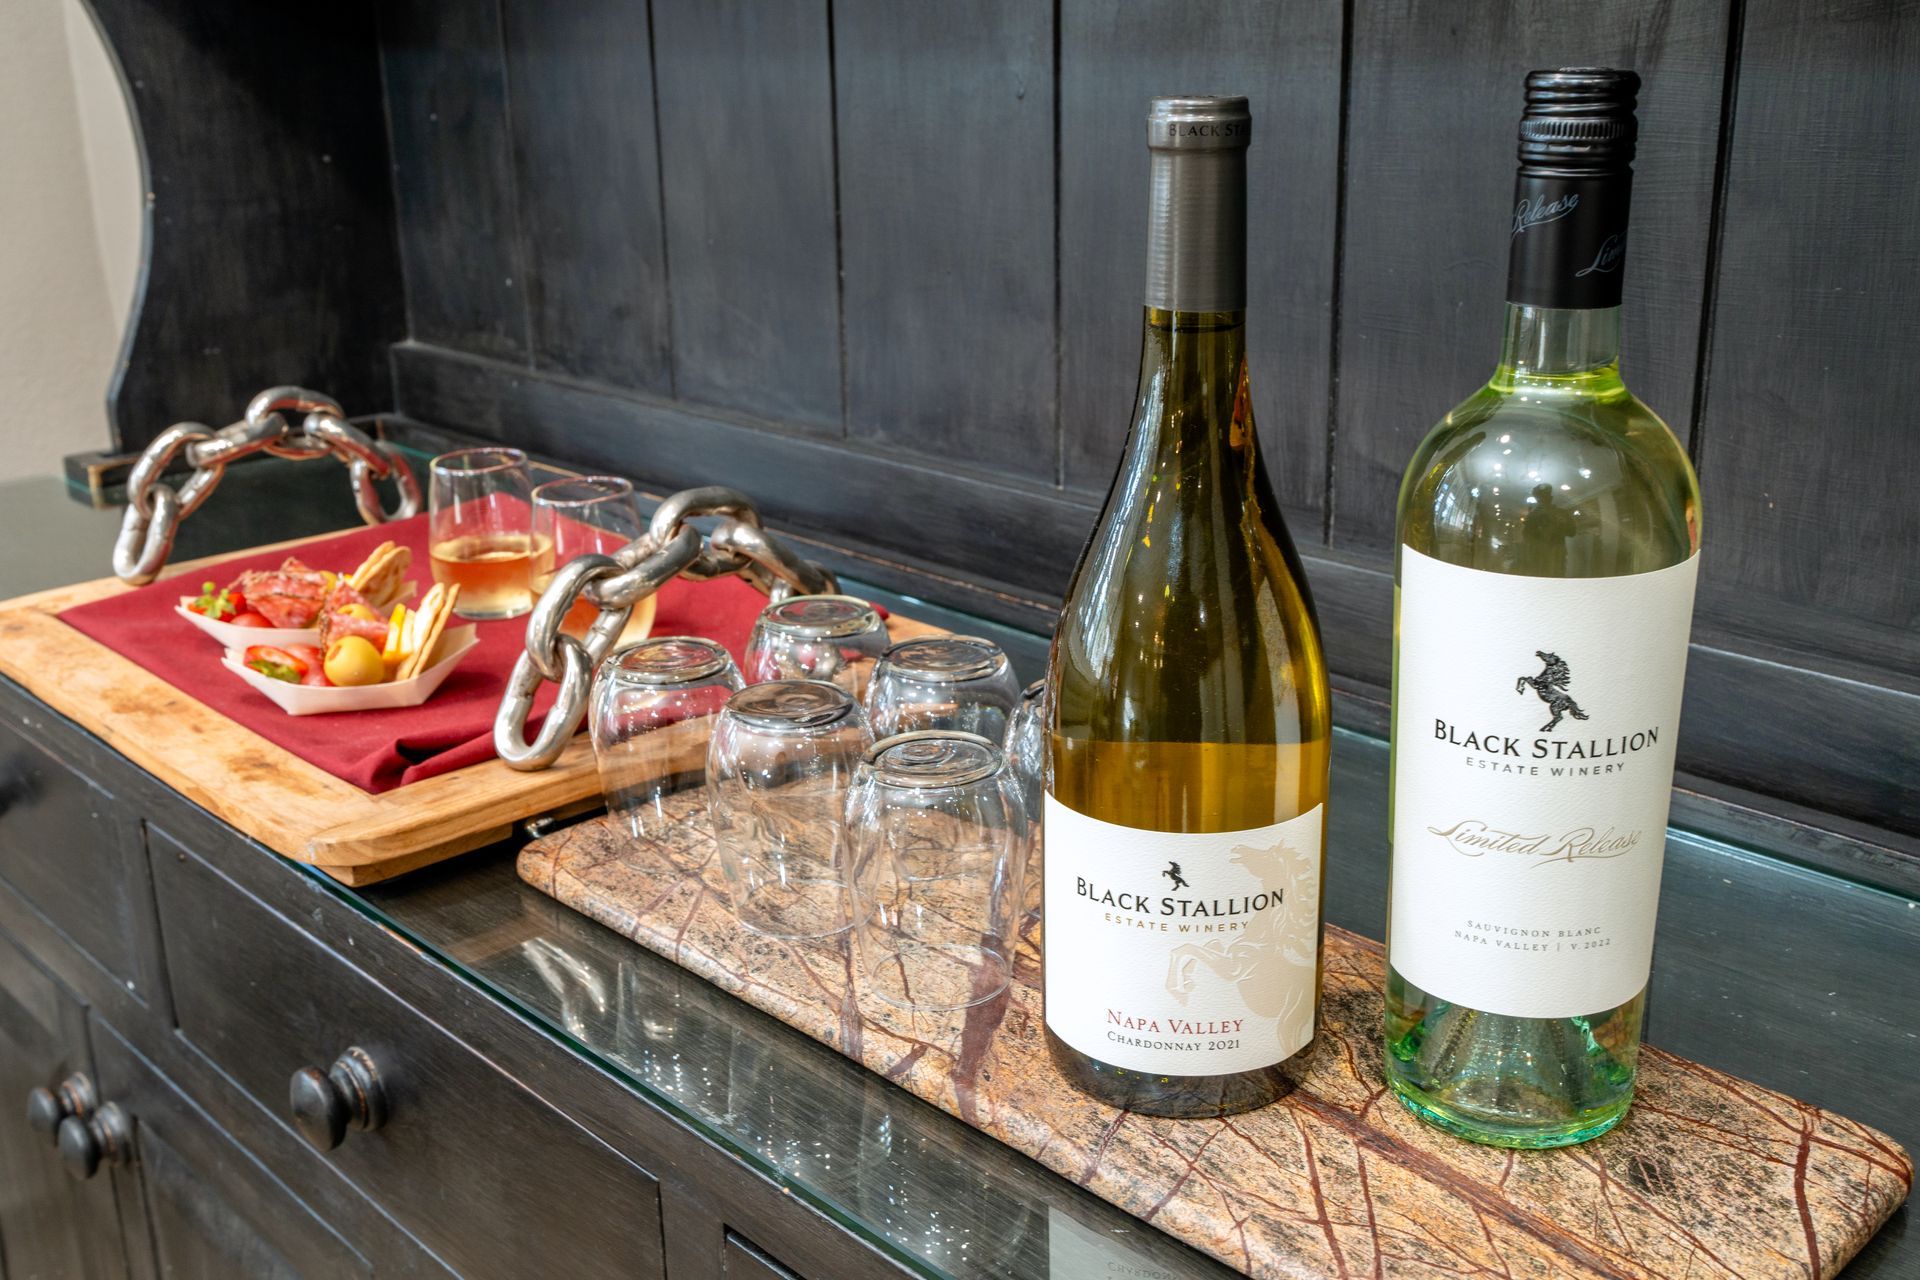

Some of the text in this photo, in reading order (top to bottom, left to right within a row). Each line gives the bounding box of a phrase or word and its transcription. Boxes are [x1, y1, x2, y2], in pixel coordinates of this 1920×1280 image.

[1169, 124, 1219, 136] BLACK
[1511, 194, 1579, 240] Release
[1434, 718, 1659, 760] BLACK STALLION
[1466, 757, 1625, 777] ESTATE WINERY
[1427, 820, 1642, 869] Limited Release
[1077, 876, 1284, 917] BLACK STALLION
[1105, 912, 1248, 933] ESTATE WINERY
[1467, 920, 1601, 938] SAUVIGNON BLANC
[1454, 930, 1487, 945] NAPA
[1496, 939, 1549, 952] VALLEY
[1107, 1008, 1243, 1035] NAPA VALLEY
[1107, 1031, 1240, 1051] CHARDONNAY 2021
